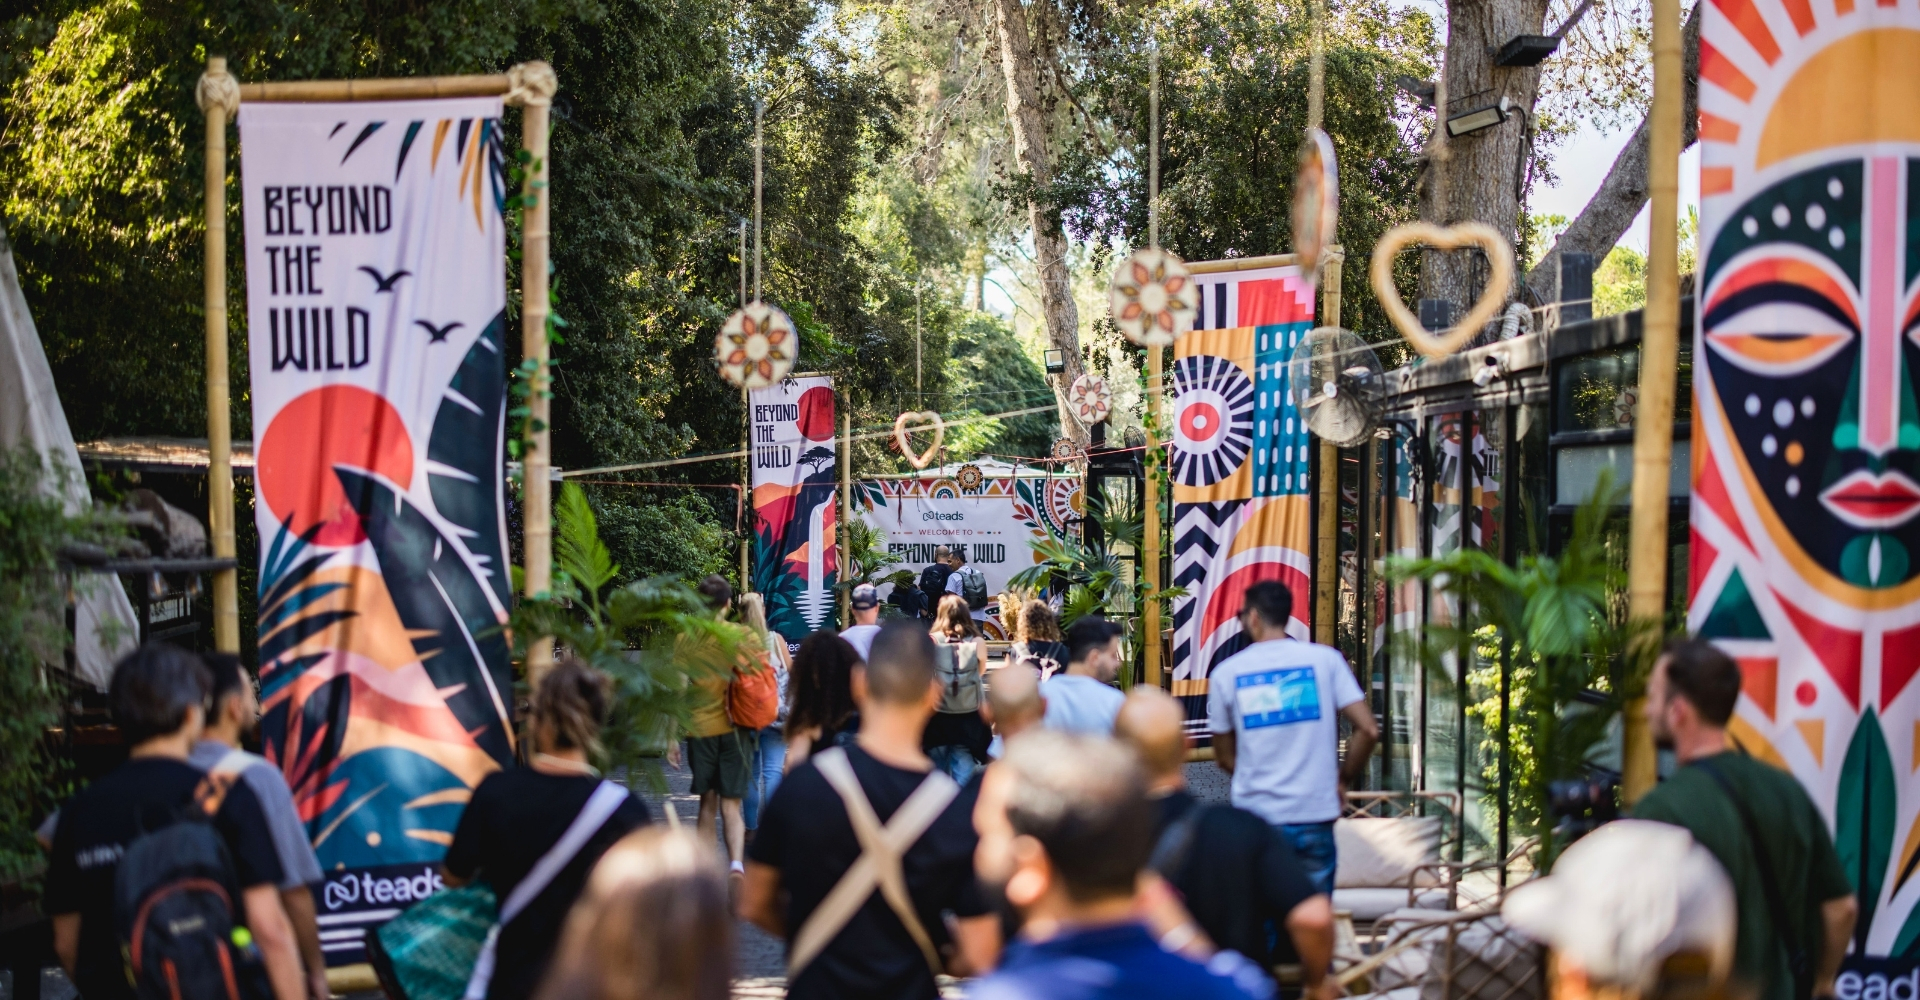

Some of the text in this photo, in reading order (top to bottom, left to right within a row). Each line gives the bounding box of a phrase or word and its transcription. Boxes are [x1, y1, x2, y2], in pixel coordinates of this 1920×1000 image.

[264, 186, 391, 235] BEYOND
[265, 246, 323, 295] THE
[270, 307, 369, 372] WILD
[756, 404, 798, 422] BEYOND
[756, 425, 775, 442] THE
[757, 445, 791, 468] WILD
[935, 511, 964, 521] teads
[973, 543, 1006, 563] WILD
[1835, 966, 1920, 1000] ead
